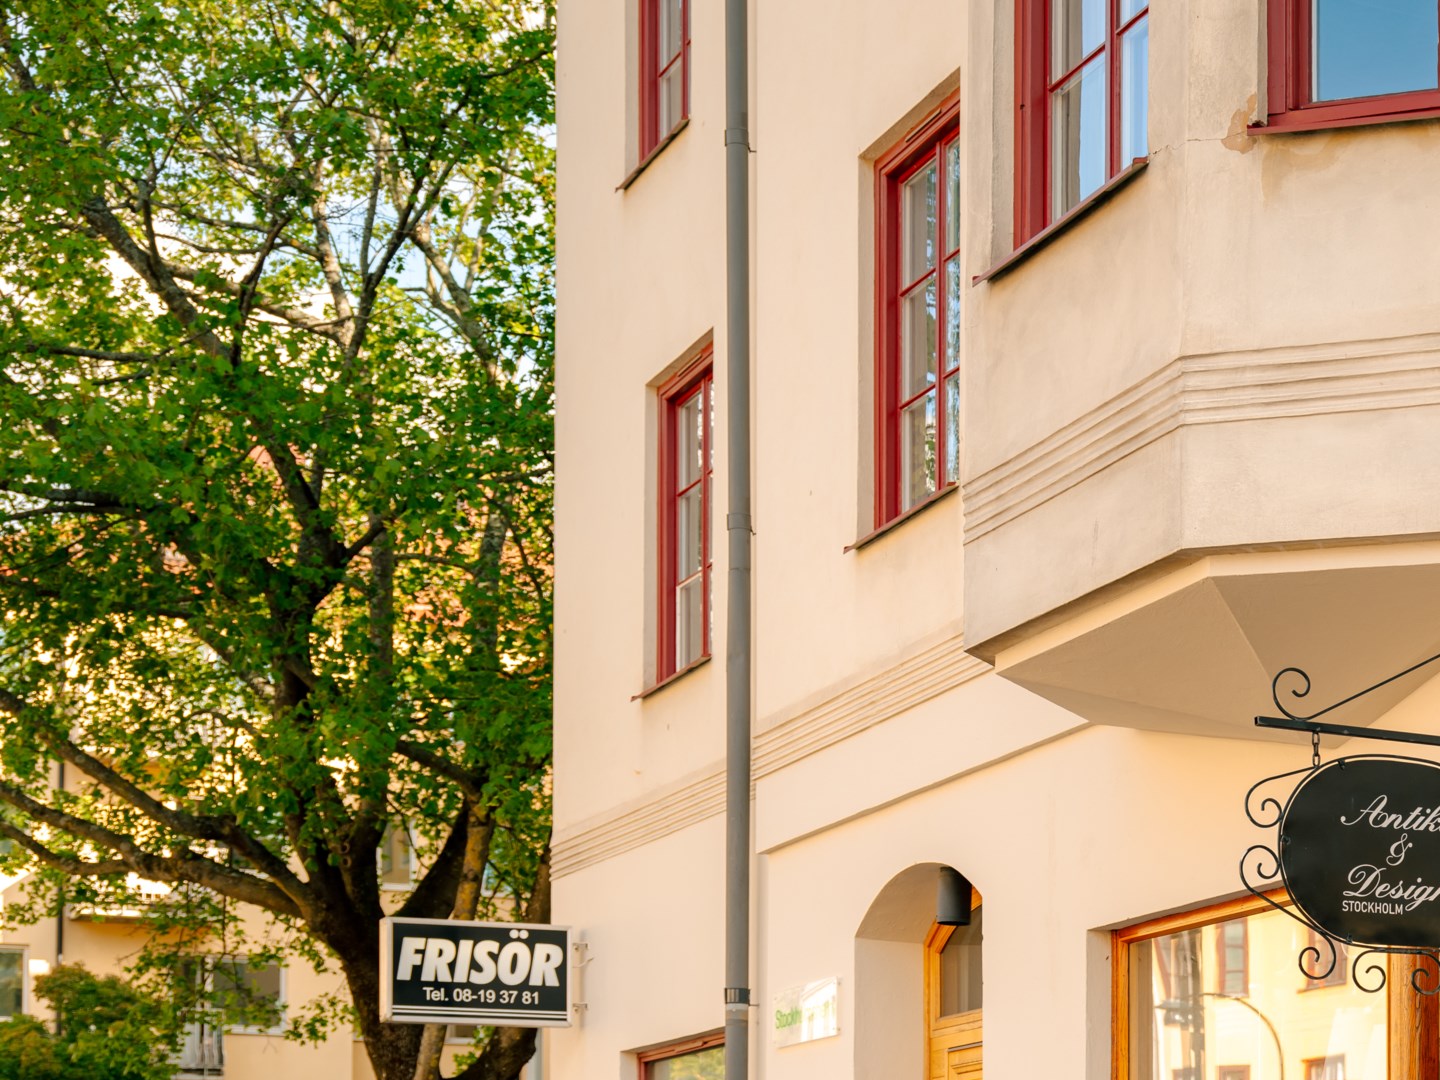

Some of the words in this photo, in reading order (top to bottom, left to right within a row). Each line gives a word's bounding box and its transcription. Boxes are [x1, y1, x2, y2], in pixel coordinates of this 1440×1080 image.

[1386, 833, 1413, 866] &
[1342, 900, 1404, 915] STOCKHOLM
[396, 929, 564, 987] FRISÖR
[422, 987, 449, 1002] Tel.
[453, 988, 496, 1003] 08-19
[499, 990, 518, 1004] 37
[521, 991, 539, 1005] 81
